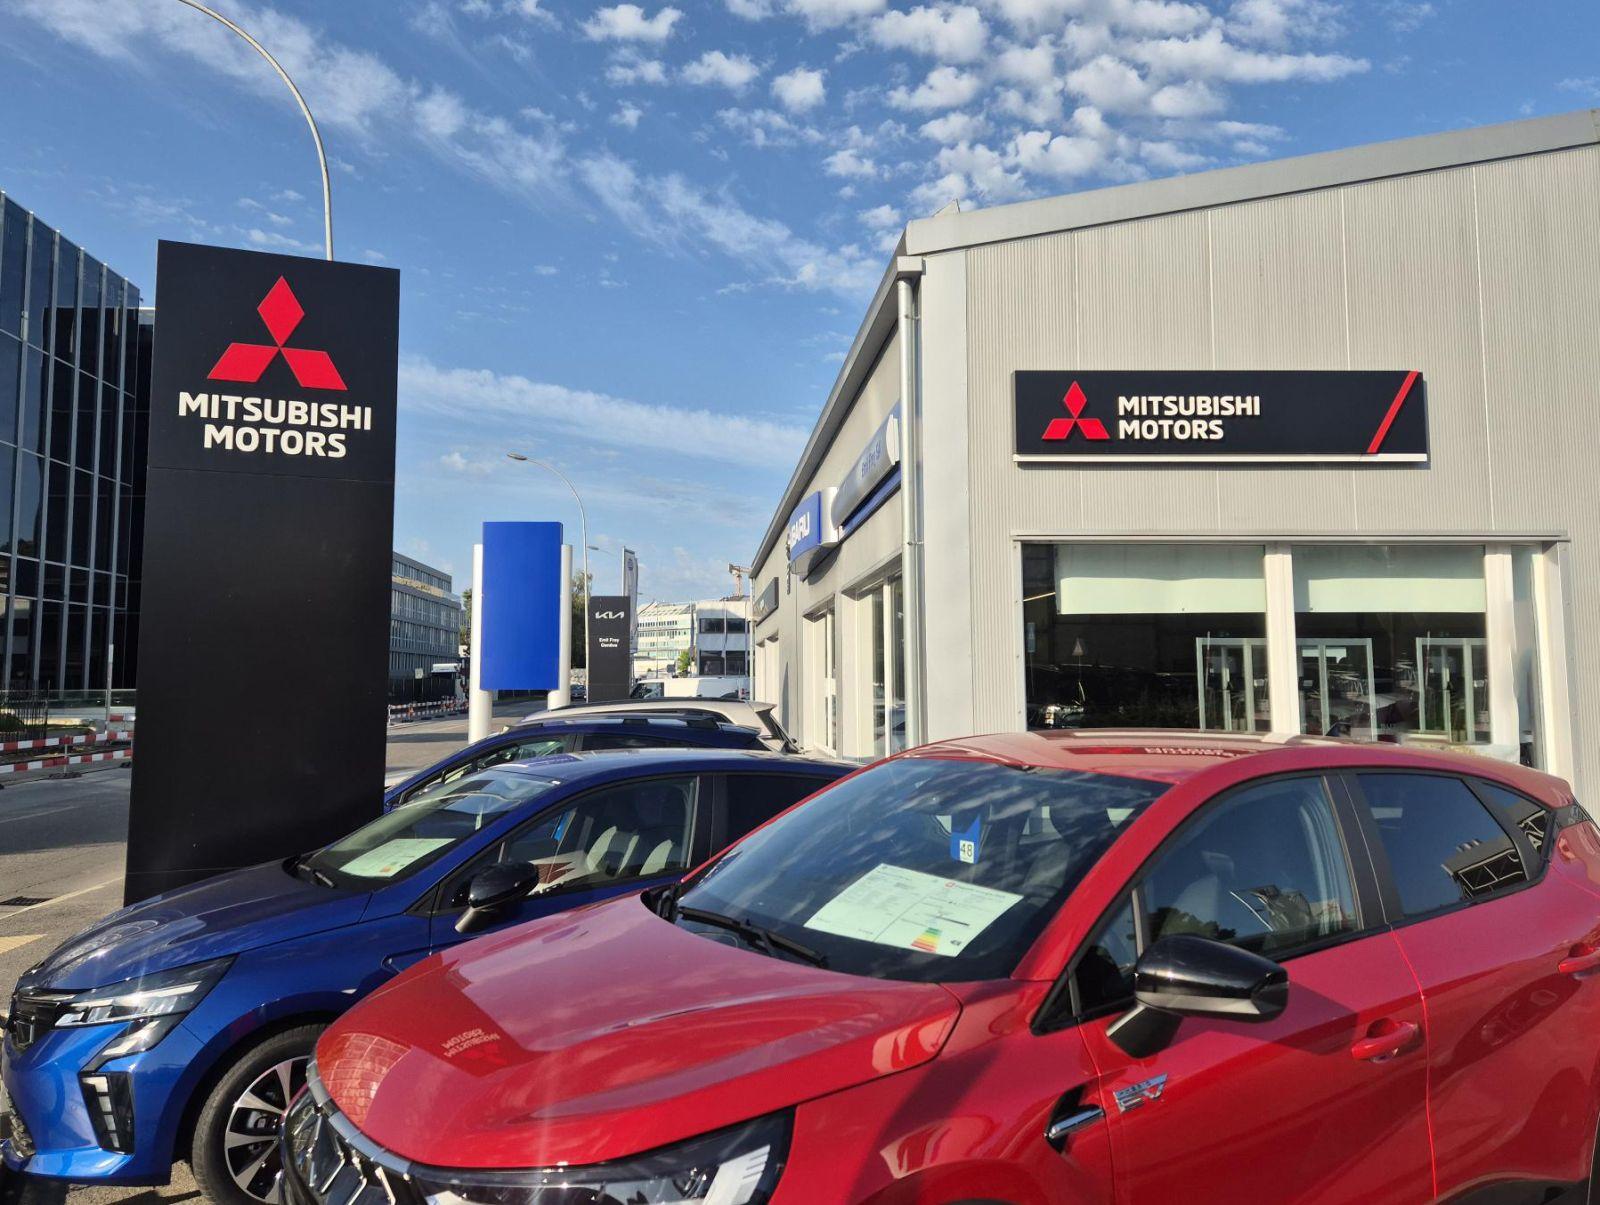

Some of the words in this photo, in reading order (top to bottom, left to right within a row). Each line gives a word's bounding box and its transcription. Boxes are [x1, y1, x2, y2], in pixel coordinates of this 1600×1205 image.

[178, 391, 372, 431] MITSUBISHI
[1118, 395, 1261, 416] MITSUBISHI
[1118, 419, 1224, 440] MOTORS
[203, 423, 347, 459] MOTORS
[595, 610, 625, 619] KIA
[960, 842, 973, 858] 48
